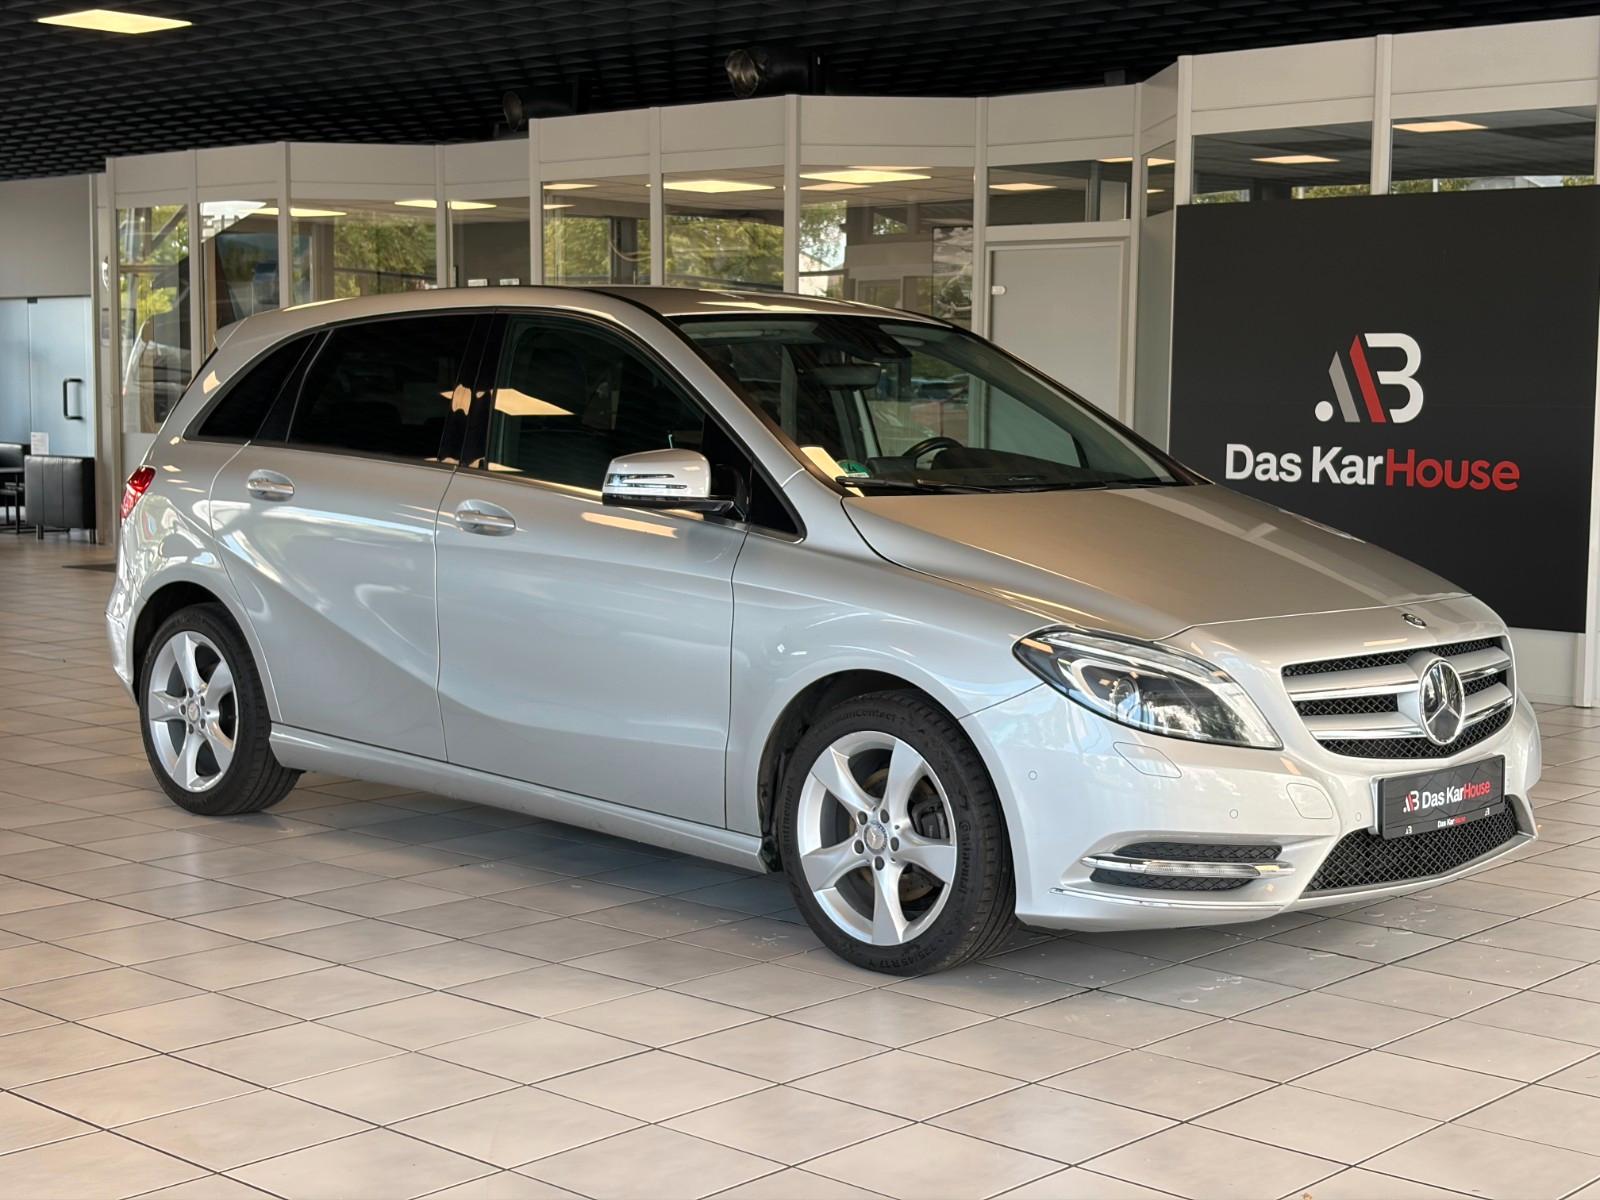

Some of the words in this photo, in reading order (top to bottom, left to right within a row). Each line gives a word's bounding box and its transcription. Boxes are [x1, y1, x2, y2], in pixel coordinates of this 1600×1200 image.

[1225, 443, 1302, 483] Das
[1311, 445, 1520, 491] KarHouse
[1422, 791, 1445, 809] Das
[1446, 780, 1491, 804] KarHouse
